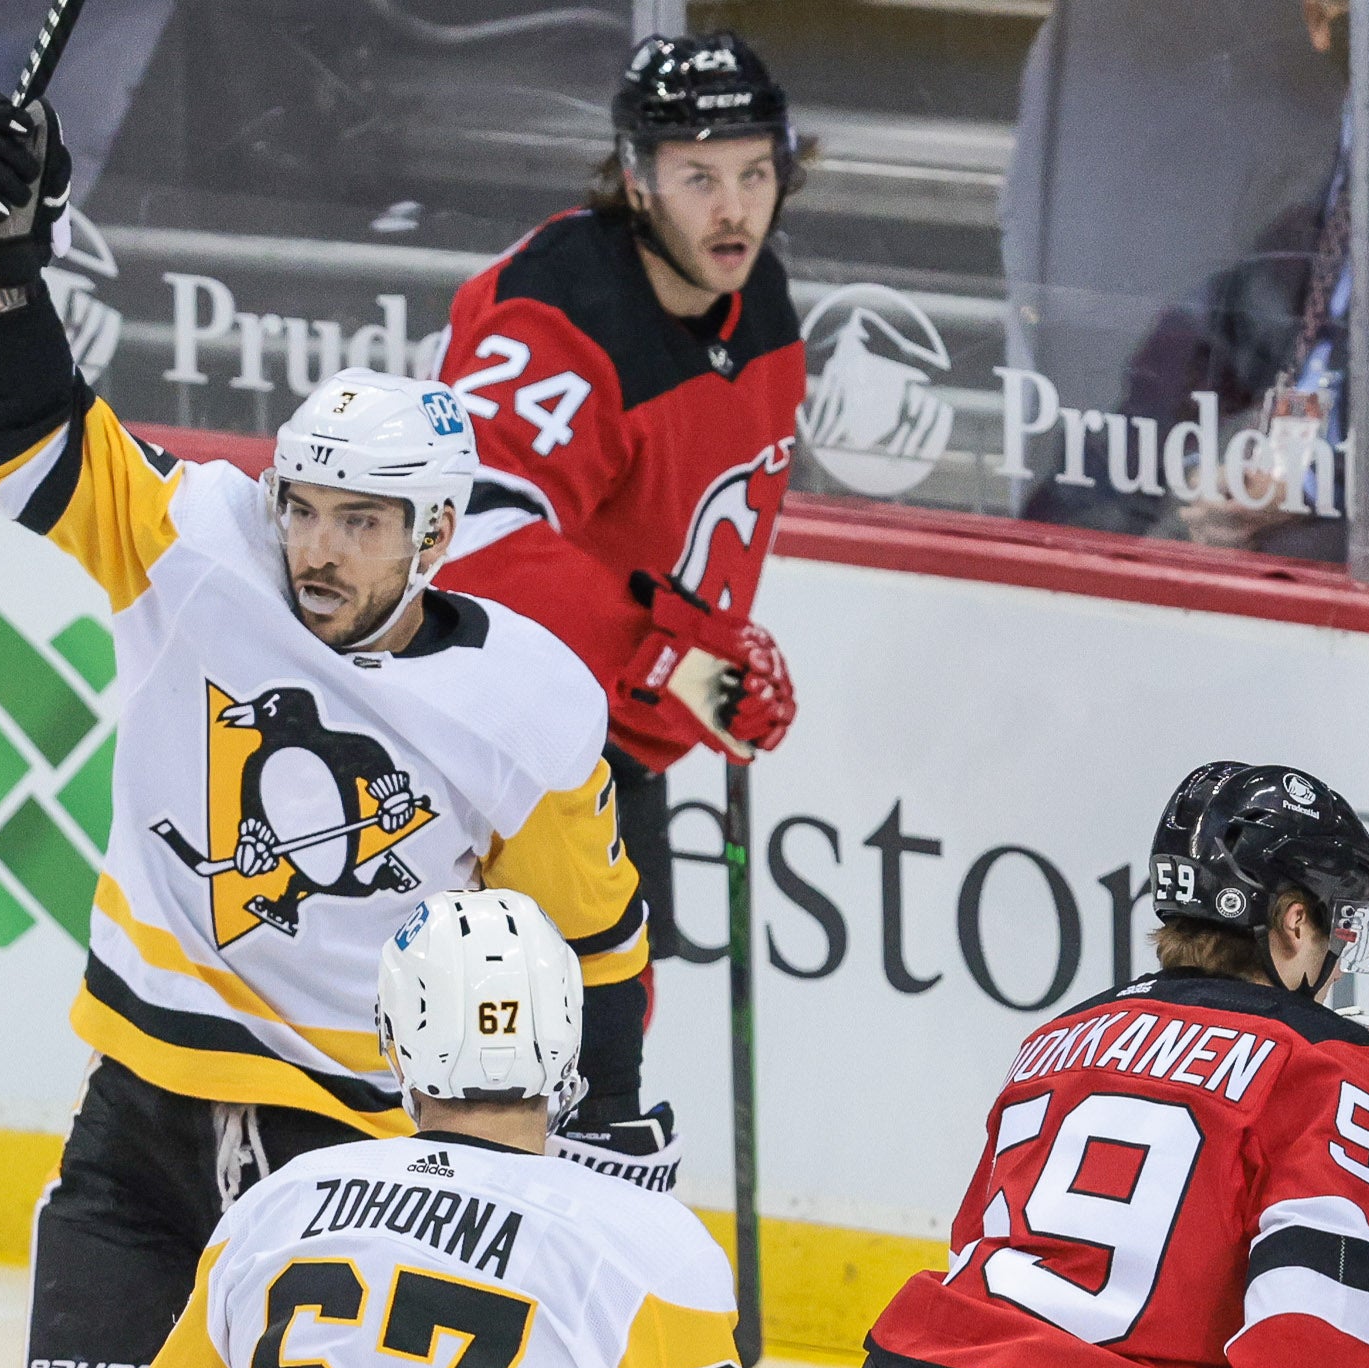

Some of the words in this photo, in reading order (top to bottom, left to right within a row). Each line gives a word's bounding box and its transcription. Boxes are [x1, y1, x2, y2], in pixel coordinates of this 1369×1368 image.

[453, 334, 592, 457] 24
[1282, 799, 1320, 821] Prudential
[1156, 862, 1195, 901] 59
[478, 1001, 519, 1035] 67
[1002, 1011, 1277, 1103] UOKKANEN
[407, 1162, 455, 1179] adidas
[301, 1180, 524, 1280] ZOHORNA
[982, 1091, 1205, 1345] 59
